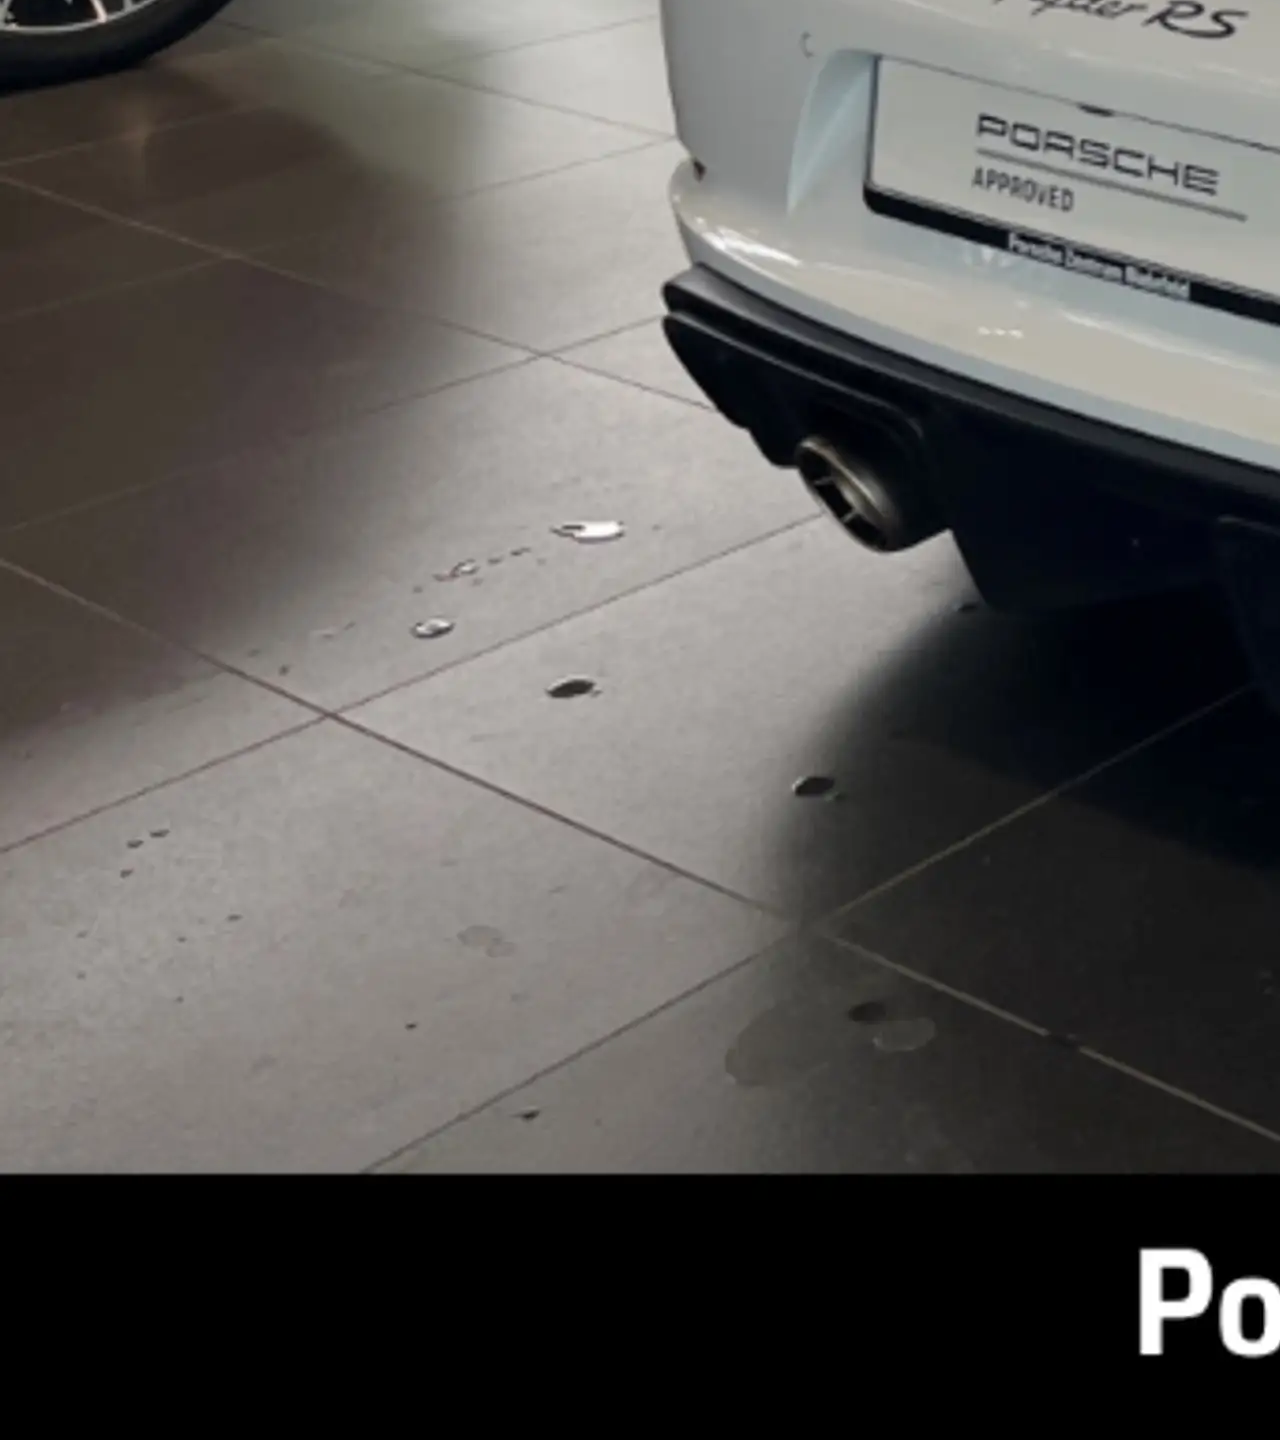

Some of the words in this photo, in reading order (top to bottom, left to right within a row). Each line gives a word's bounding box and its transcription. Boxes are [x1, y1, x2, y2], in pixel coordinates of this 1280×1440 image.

[1141, 0, 1249, 39] RS
[975, 113, 1220, 197] PORSCHE
[970, 166, 1076, 212] APPROVED
